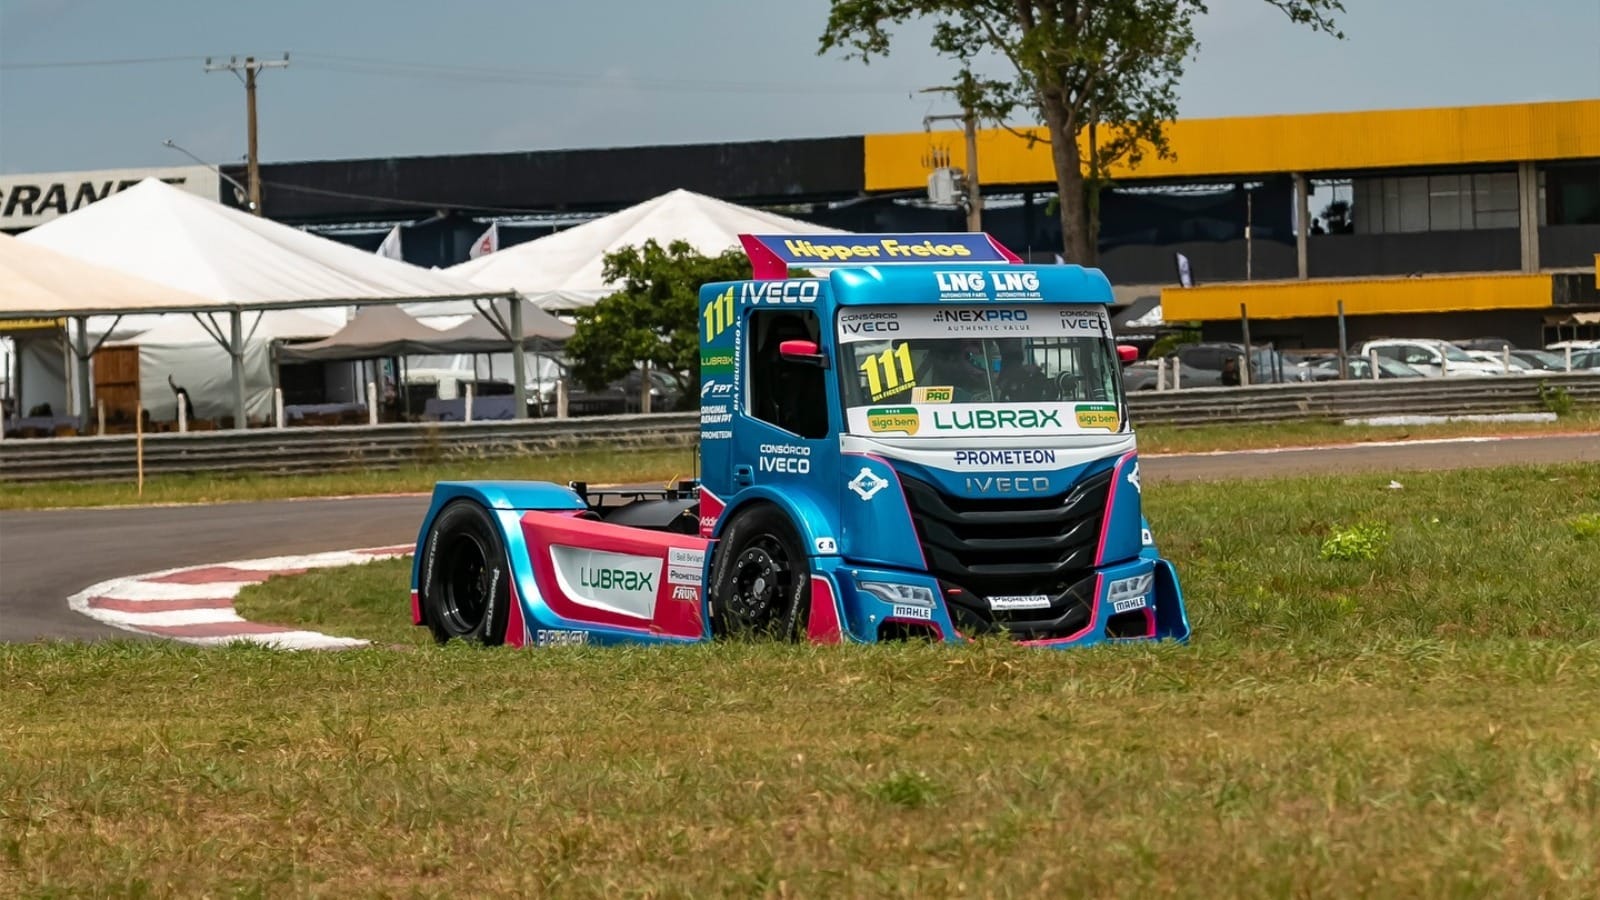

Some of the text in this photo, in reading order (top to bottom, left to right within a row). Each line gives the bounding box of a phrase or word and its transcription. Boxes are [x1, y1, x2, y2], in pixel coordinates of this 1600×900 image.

[784, 239, 971, 260] Hipper Freios
[934, 272, 986, 291] LNG
[988, 271, 1040, 291] LNG
[740, 281, 819, 304] IVECO
[703, 285, 735, 343] 111
[841, 312, 898, 321] CONSÓRCIO
[944, 309, 1028, 322] NEXPRO
[842, 321, 900, 334] IVECO
[1061, 319, 1108, 330] IVECO
[861, 342, 914, 395] 111
[712, 384, 733, 393] FPT
[926, 392, 950, 400] PRO
[871, 416, 917, 428] siga bem
[1079, 412, 1115, 424] siga bem
[701, 431, 732, 439] PROMETEON
[760, 443, 811, 455] CONSÓRCIO
[954, 450, 1056, 464] PROMETEON
[760, 457, 810, 474] IVECO
[965, 477, 1049, 492] IVECO
[672, 586, 699, 600] FRUM
[1116, 598, 1145, 611] MAHLE
[895, 607, 929, 617] MAHLE
